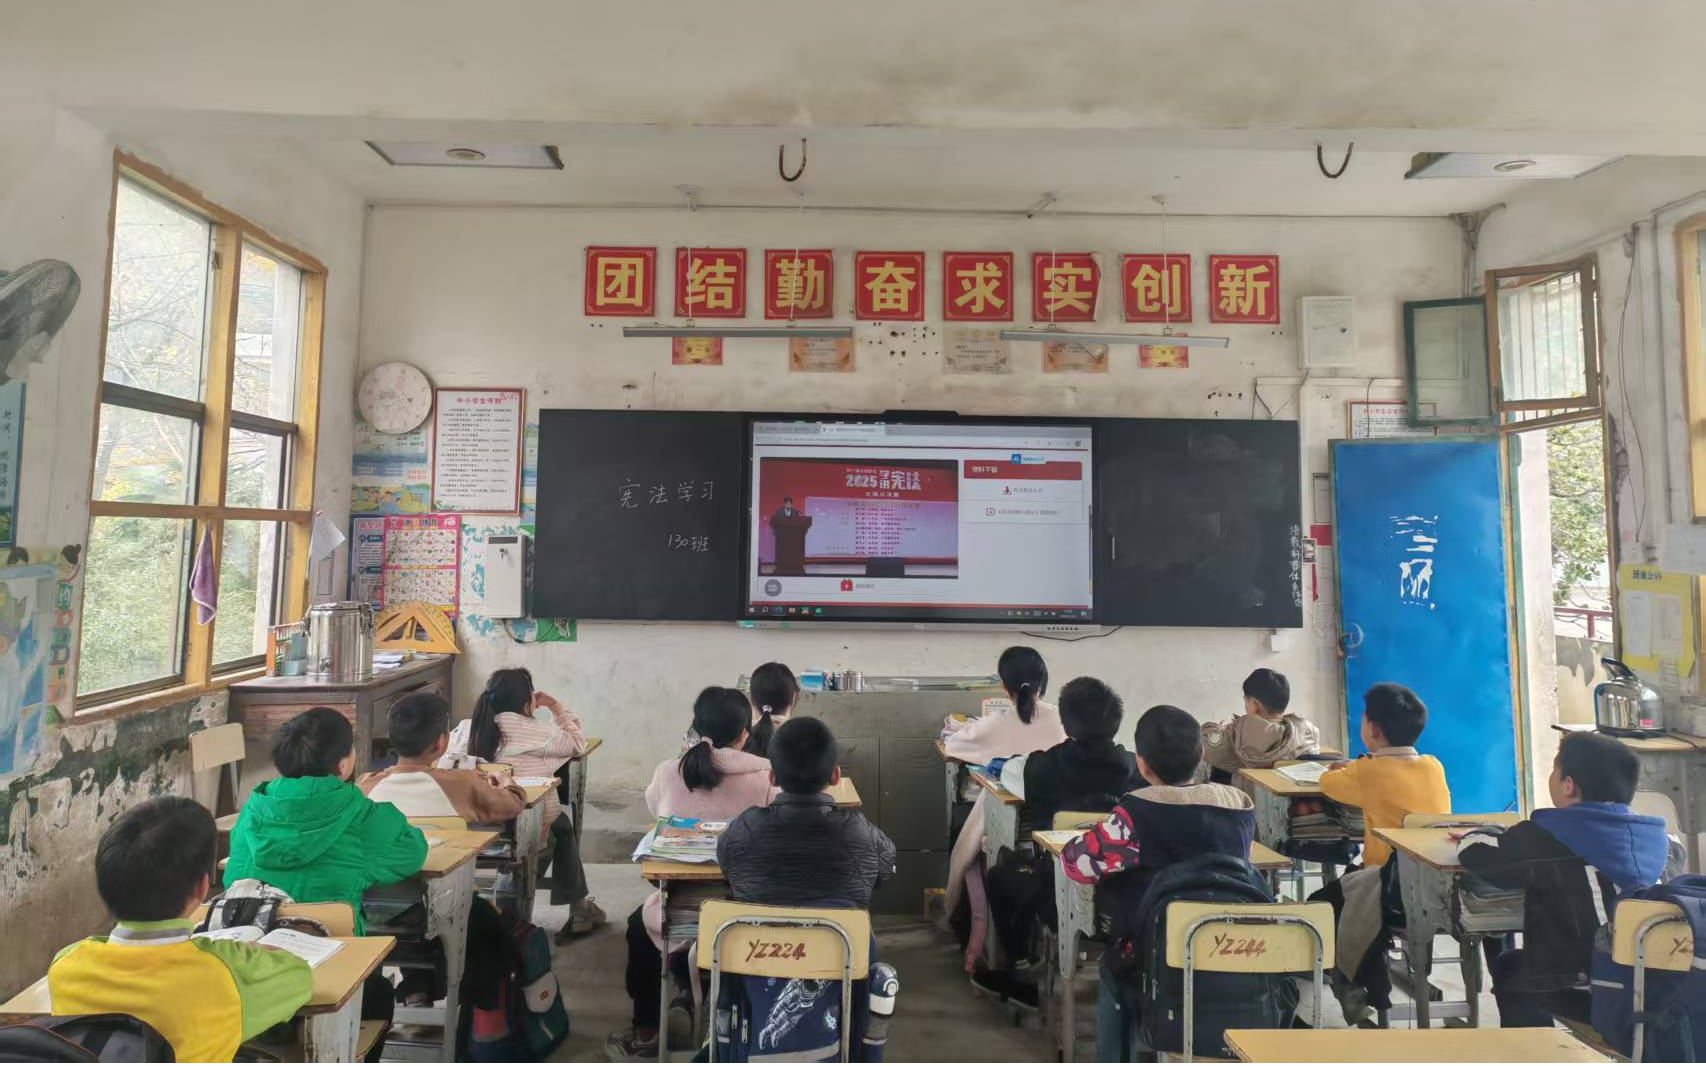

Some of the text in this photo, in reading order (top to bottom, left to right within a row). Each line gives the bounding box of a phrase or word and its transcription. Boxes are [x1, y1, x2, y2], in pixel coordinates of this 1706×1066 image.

[595, 255, 1271, 316] 团结勤奋求实创新
[619, 478, 713, 508] 宪法学习
[668, 534, 711, 553] 130班
[745, 938, 806, 963] YZ224
[1208, 931, 1266, 959] YZ244
